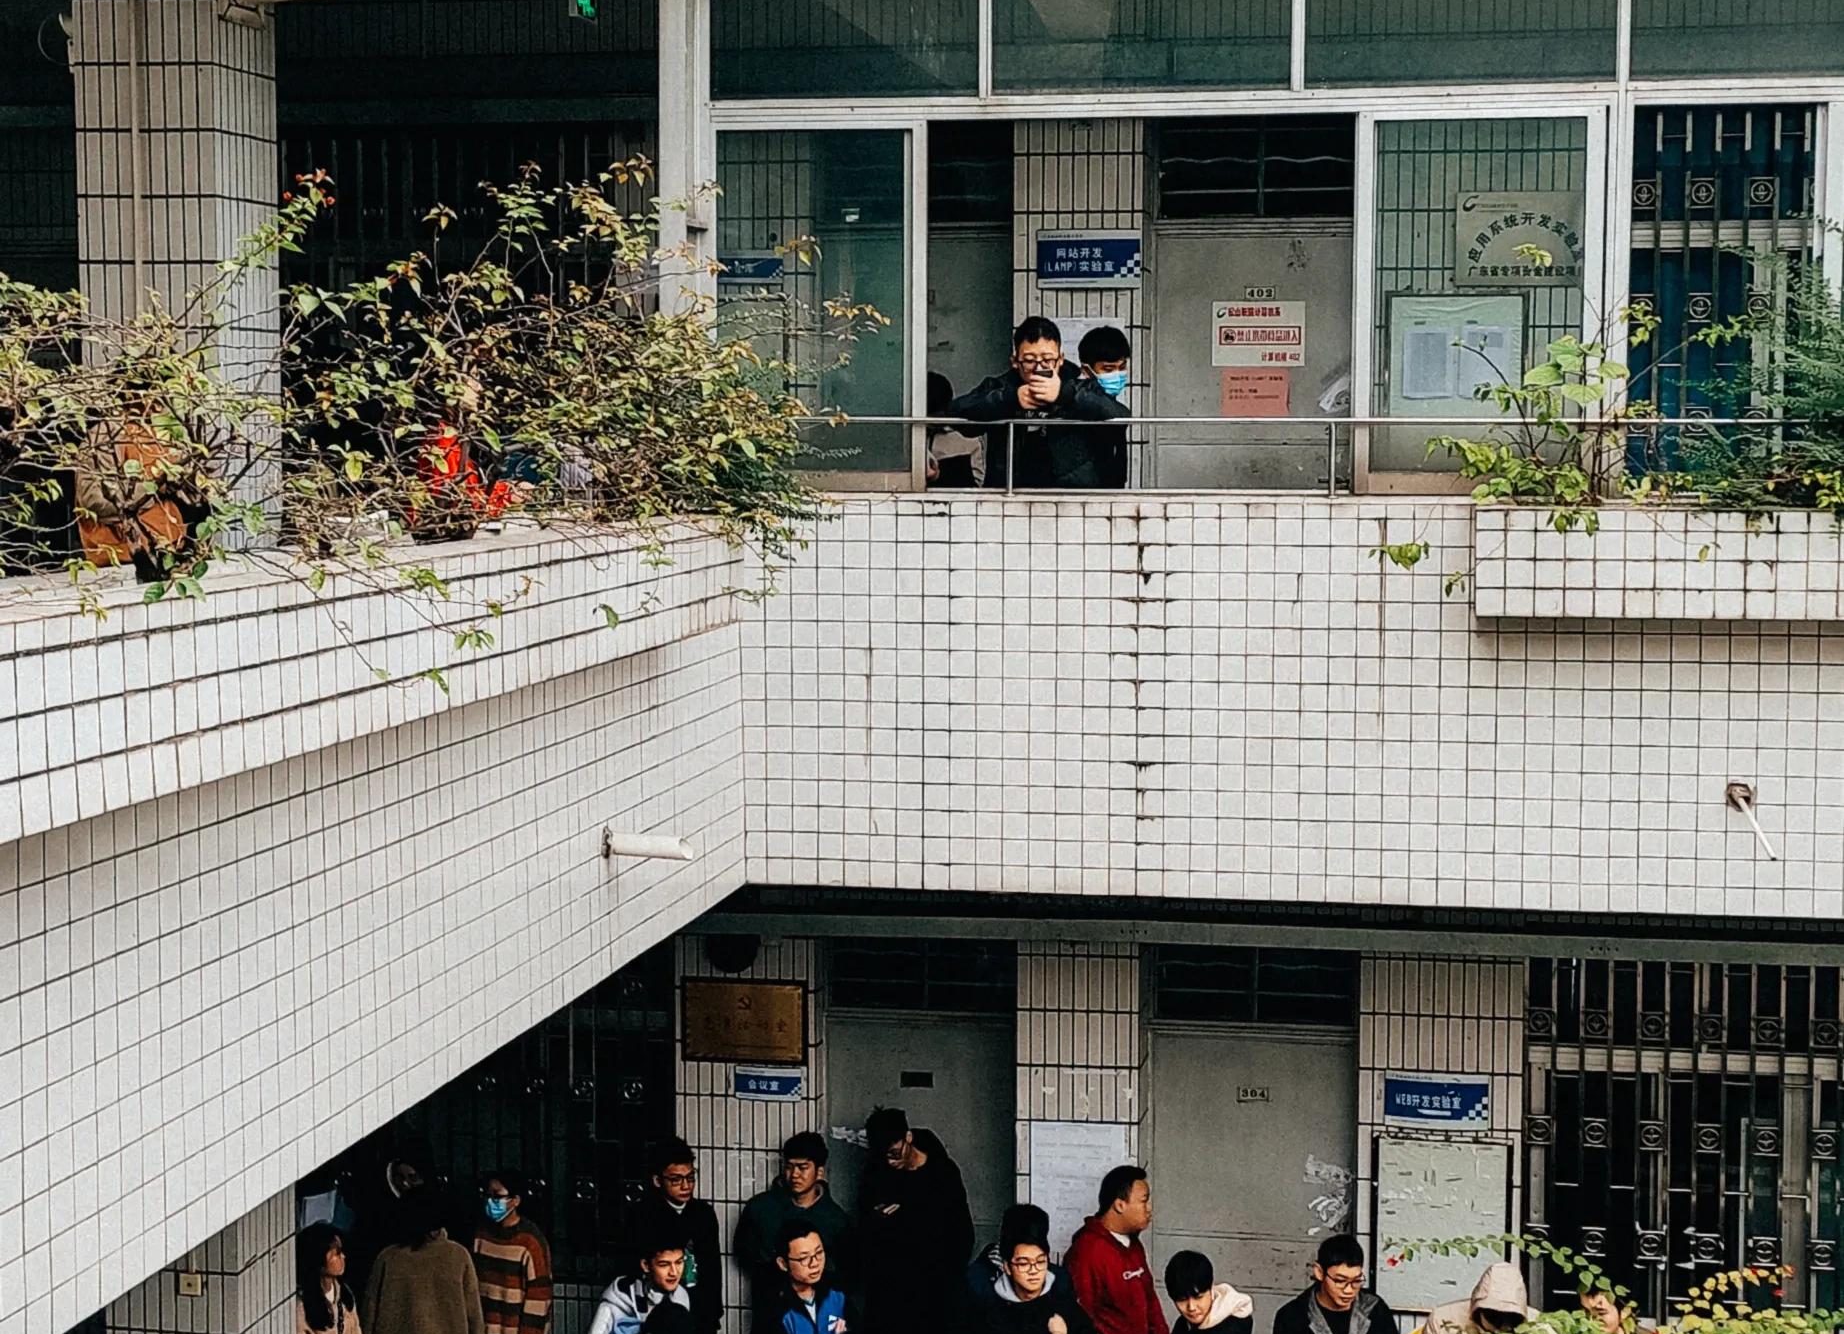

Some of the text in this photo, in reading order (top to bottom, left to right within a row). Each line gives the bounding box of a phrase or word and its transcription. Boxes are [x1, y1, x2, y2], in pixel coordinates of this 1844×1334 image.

[1056, 247, 1103, 259] 网站开发
[1247, 288, 1274, 298] 402
[747, 1079, 780, 1091] 会议室
[1395, 1093, 1462, 1110] WEB开发实验室
